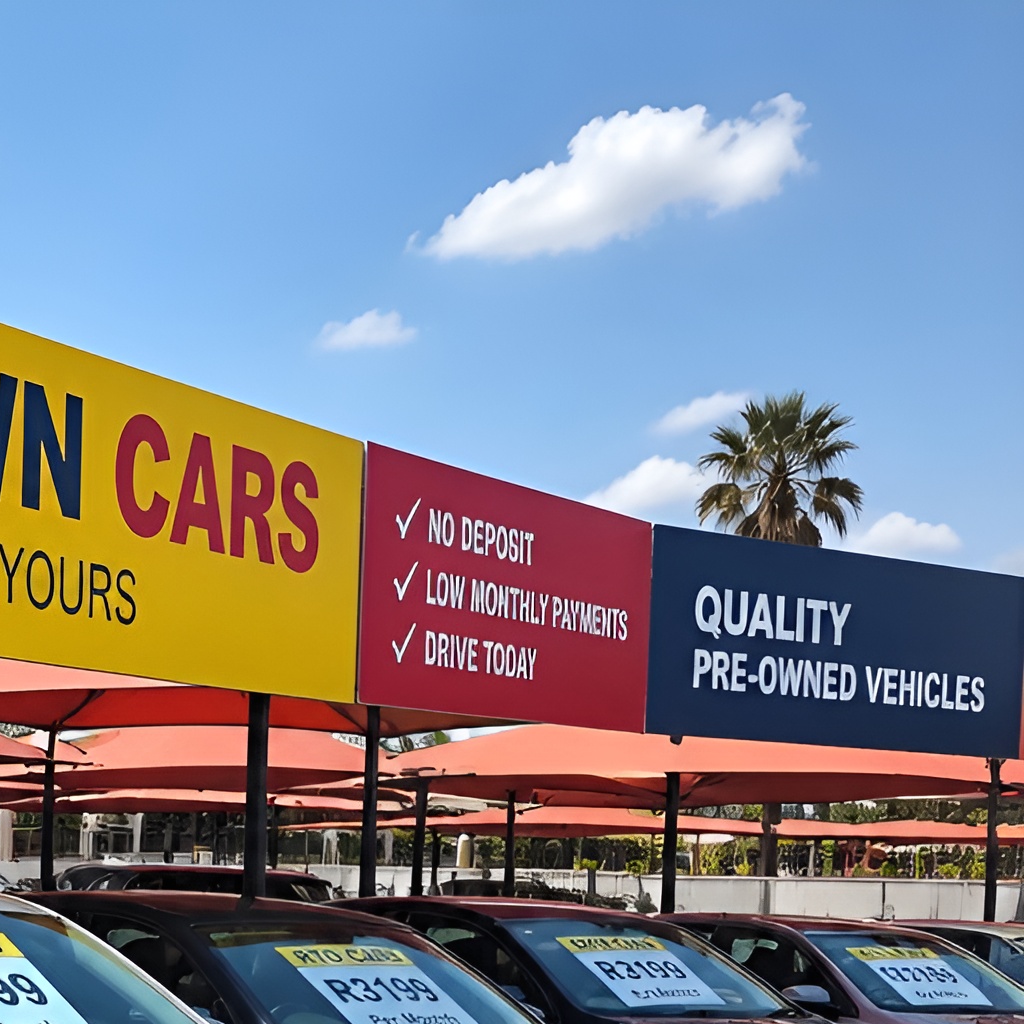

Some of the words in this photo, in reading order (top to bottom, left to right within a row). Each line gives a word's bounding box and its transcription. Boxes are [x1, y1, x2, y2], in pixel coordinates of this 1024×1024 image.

[115, 413, 319, 573] CARS
[428, 507, 455, 546] NO
[461, 515, 535, 566] DEPOSIT
[426, 568, 465, 608] LOW
[471, 578, 550, 628] MONTHLY
[552, 596, 628, 641] PAYMENTS
[694, 584, 852, 647] QUALITY
[424, 629, 478, 673] DRIVE
[483, 639, 537, 681] TODAY
[692, 648, 857, 702] PRE-OWNED
[865, 665, 985, 714] VEHICLES
[323, 976, 439, 1004] R3199
